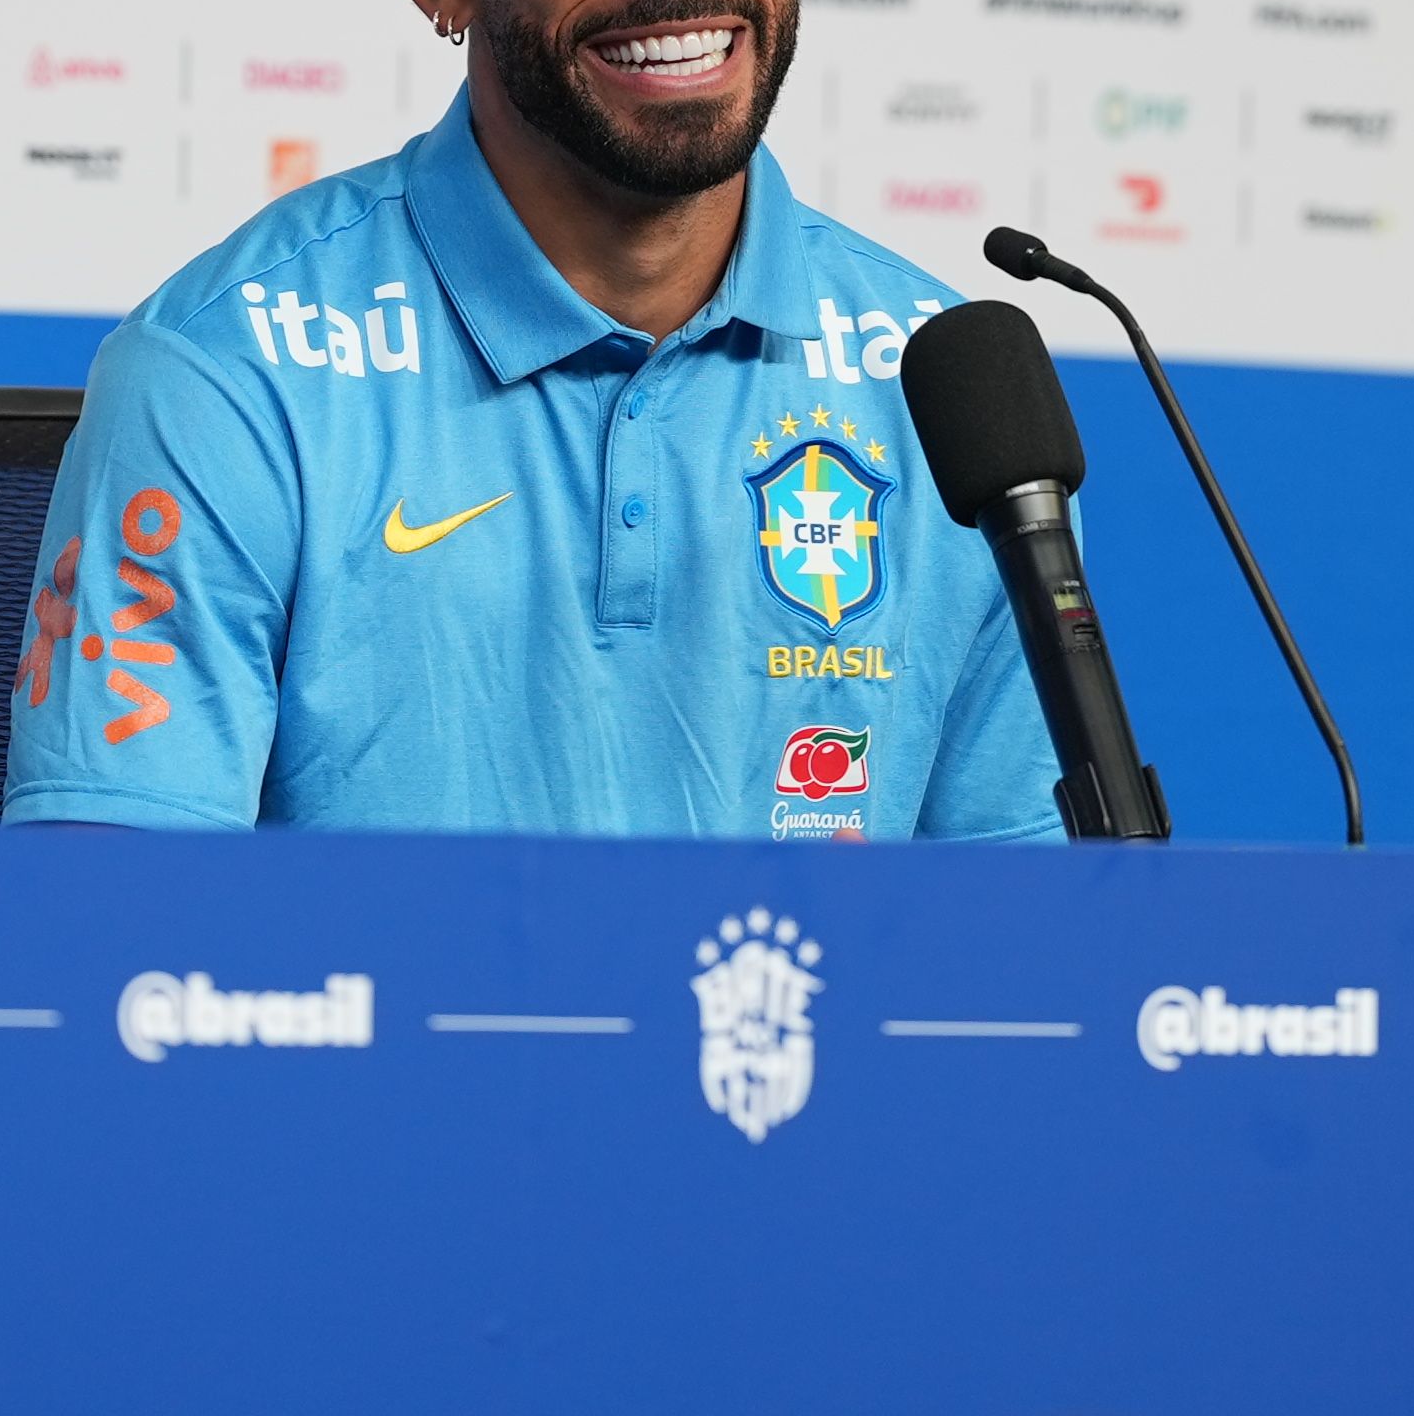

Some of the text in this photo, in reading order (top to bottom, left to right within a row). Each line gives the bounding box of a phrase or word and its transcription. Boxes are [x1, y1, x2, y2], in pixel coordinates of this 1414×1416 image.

[242, 282, 420, 384] itaú
[794, 523, 841, 544] CBF
[80, 485, 182, 744] vivo
[767, 644, 893, 679] BRASIL
[771, 800, 865, 842] Guaraná
[118, 972, 373, 1061] @brasil
[1137, 986, 1378, 1070] @brasil
